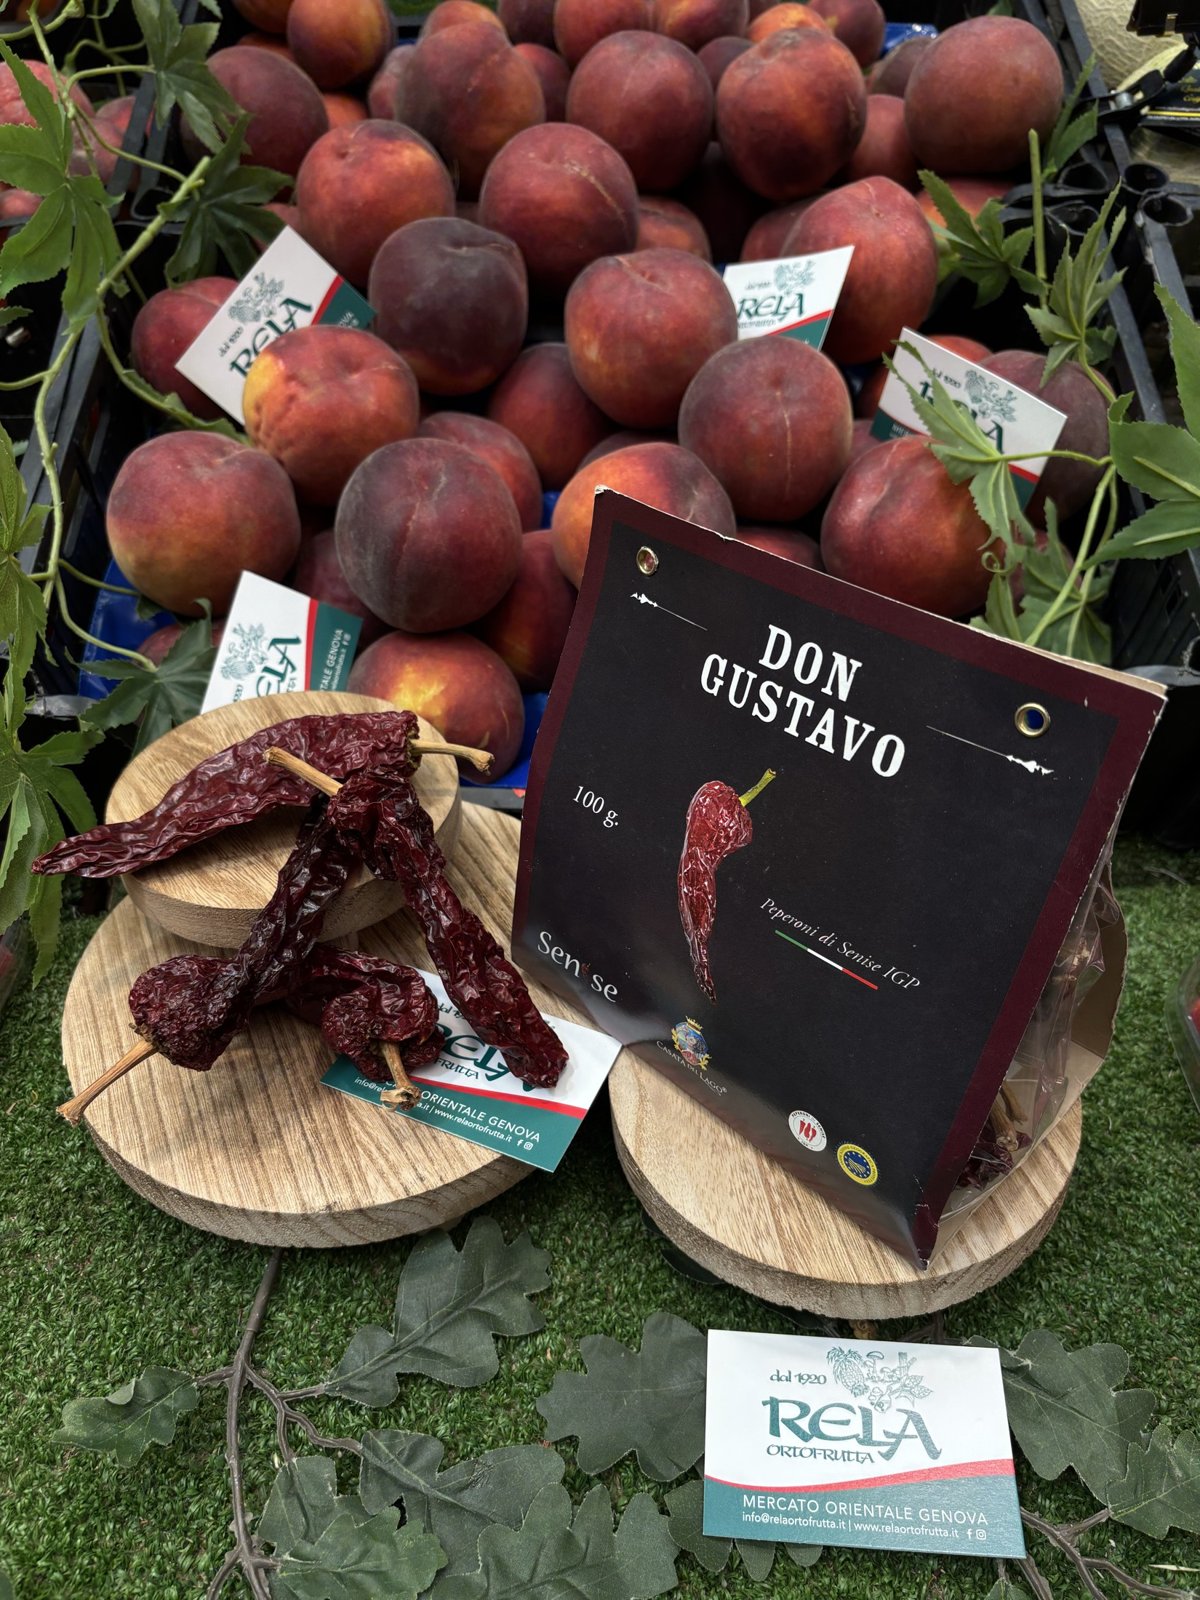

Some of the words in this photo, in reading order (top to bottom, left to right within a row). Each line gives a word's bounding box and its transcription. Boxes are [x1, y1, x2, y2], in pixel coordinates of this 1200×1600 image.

[737, 293, 805, 322] RELA
[256, 635, 302, 697] ELA
[326, 629, 343, 667] GENOVA
[758, 624, 863, 702] DON
[700, 653, 906, 777] GUSTAVO
[573, 785, 605, 814] 100
[603, 810, 619, 828] g.
[760, 898, 820, 937] Peperoni
[818, 932, 838, 947] di
[837, 941, 882, 972] Senise
[883, 966, 921, 990] IGP
[434, 1058, 479, 1080] FRUTTA
[421, 1090, 486, 1121] ORIENTALE
[488, 1116, 540, 1142] GENOVA
[434, 1108, 513, 1143] www.relaortofrutta.it
[770, 1369, 791, 1383] dal
[794, 1372, 827, 1386] 1920
[762, 1396, 942, 1461] RELA
[766, 1444, 876, 1464] ORTOFRUTTA
[742, 1511, 846, 1529] info@relaortofrutta.it
[854, 1522, 959, 1538] www.relaortofrutta.it
[743, 1494, 819, 1513] MERCATO
[825, 1501, 912, 1520] ORIENTALE
[919, 1508, 988, 1526] GENOVA
